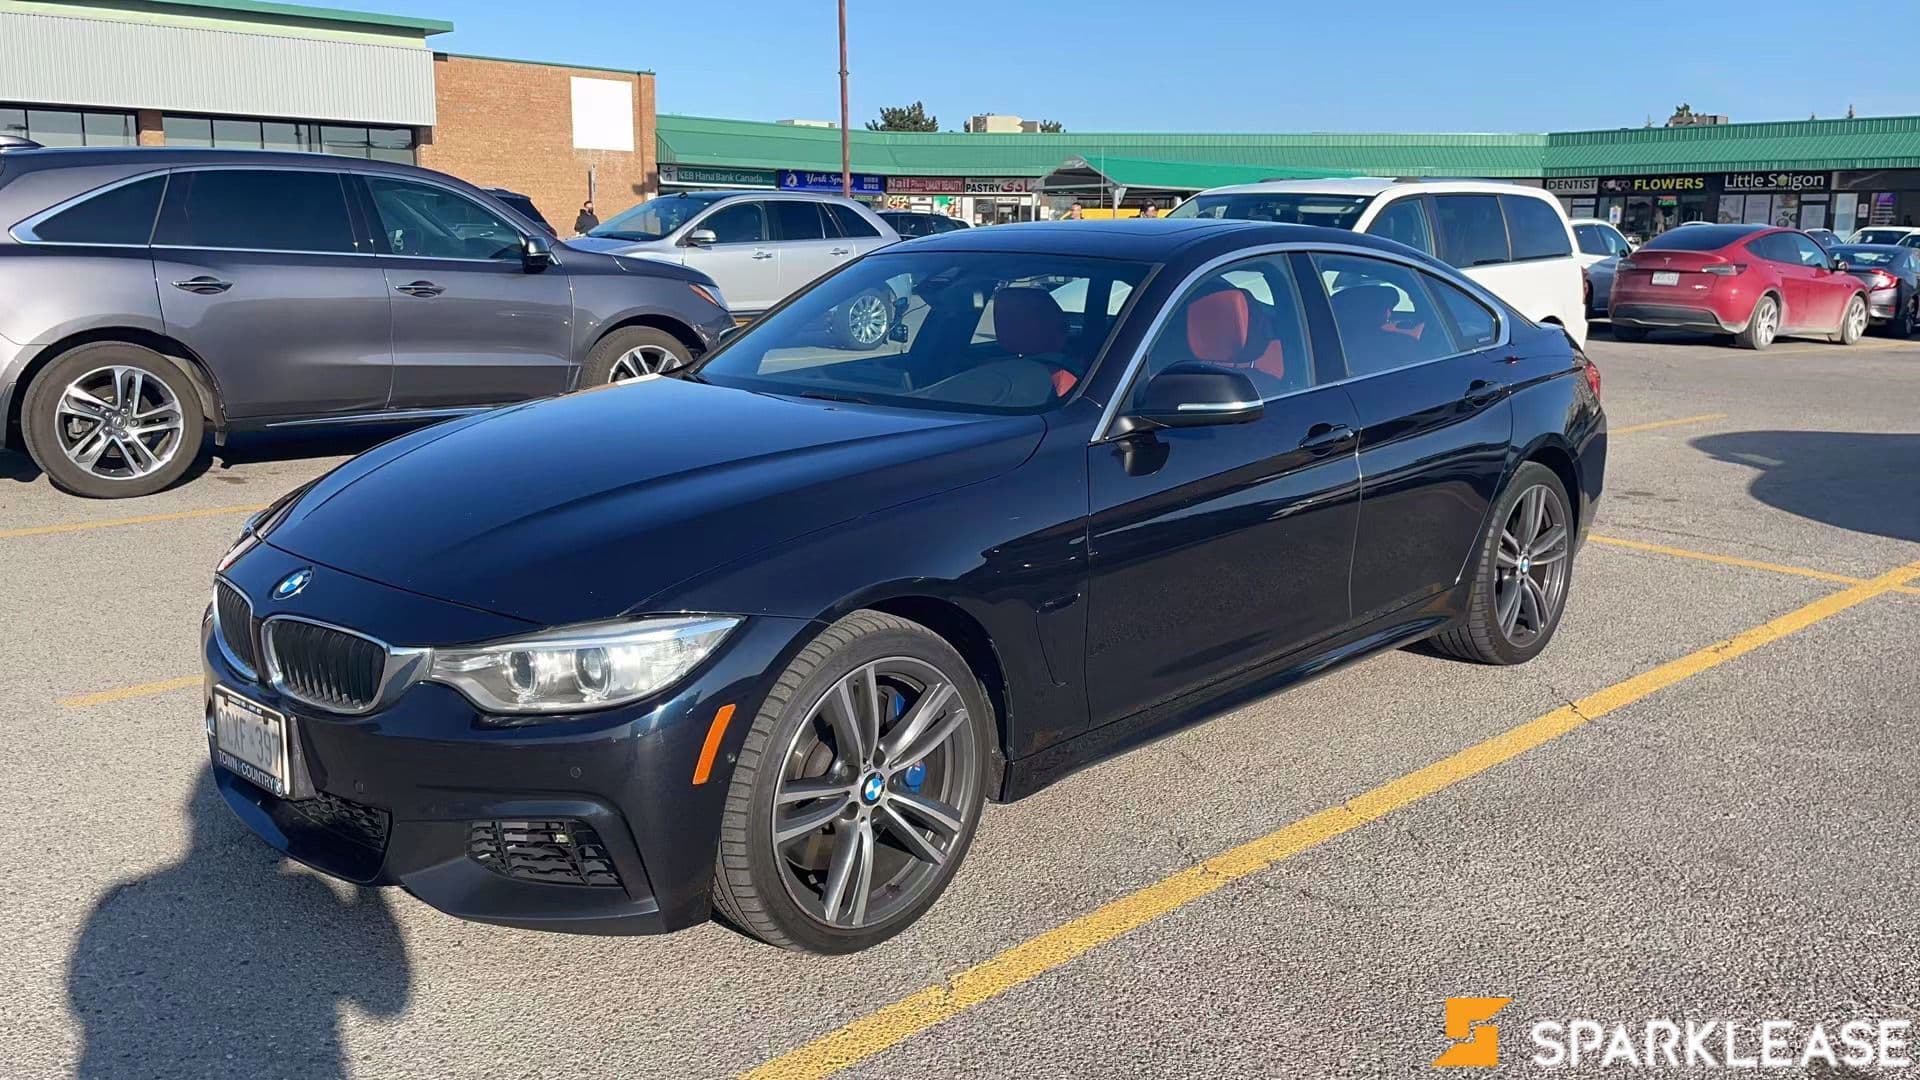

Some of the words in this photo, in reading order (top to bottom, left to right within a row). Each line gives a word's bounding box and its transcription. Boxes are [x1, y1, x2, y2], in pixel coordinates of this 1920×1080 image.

[716, 172, 734, 182] Bank
[736, 173, 763, 183] Canada
[887, 176, 910, 188] Nail
[1724, 173, 1764, 188] Little
[1767, 173, 1824, 191] Sigon
[965, 183, 1001, 193] PASTRY
[1549, 179, 1597, 190] DENTIST
[1633, 178, 1704, 191] FLOWERS
[218, 749, 238, 771] TOWN
[241, 762, 275, 790] COUNTRY
